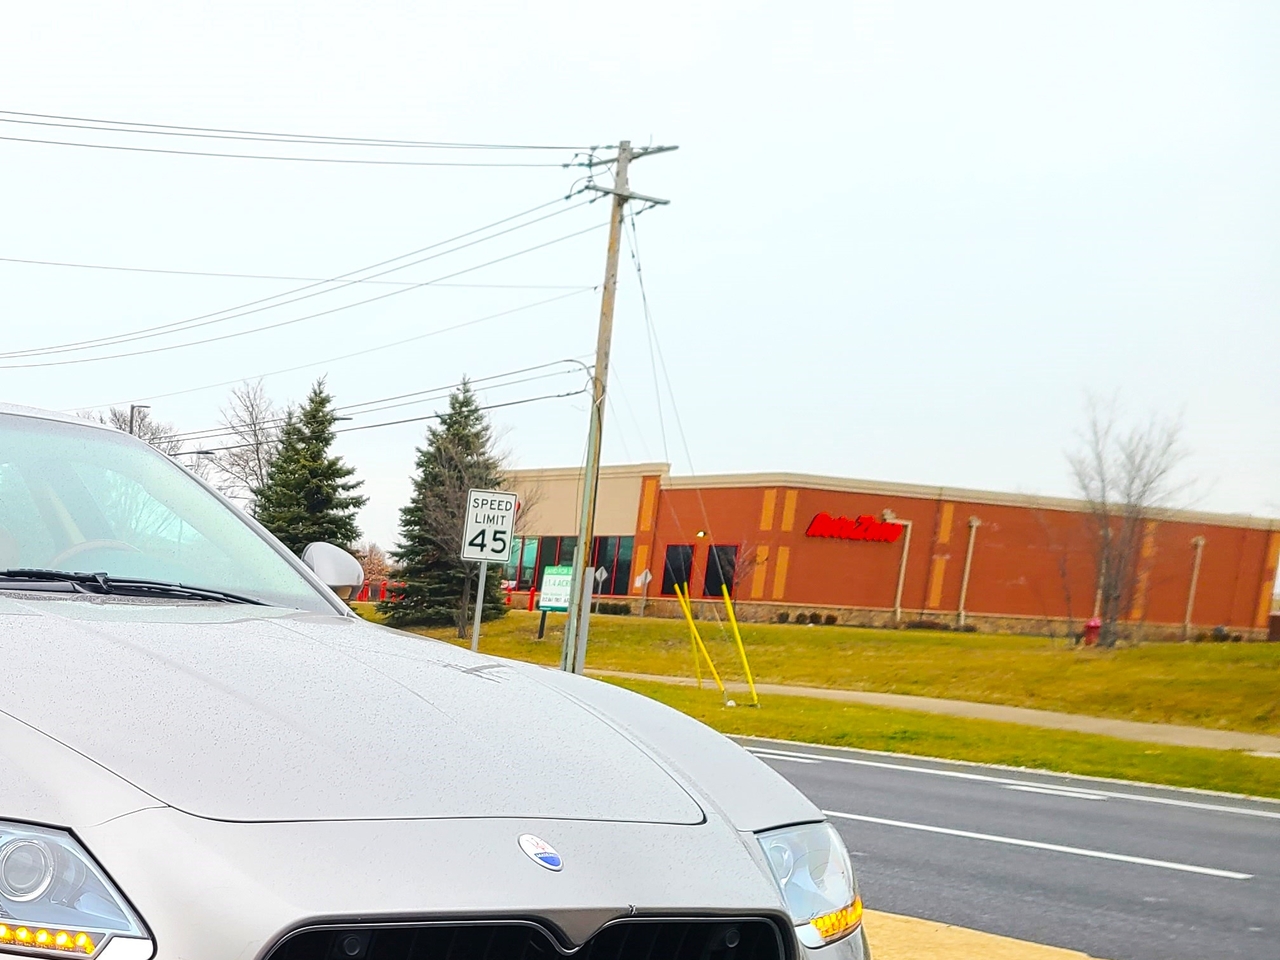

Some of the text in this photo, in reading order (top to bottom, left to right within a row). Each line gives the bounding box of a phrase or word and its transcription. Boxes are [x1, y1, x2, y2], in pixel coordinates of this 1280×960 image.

[472, 498, 513, 512] SPEED
[474, 513, 507, 526] LIMIT
[468, 529, 507, 554] 45
